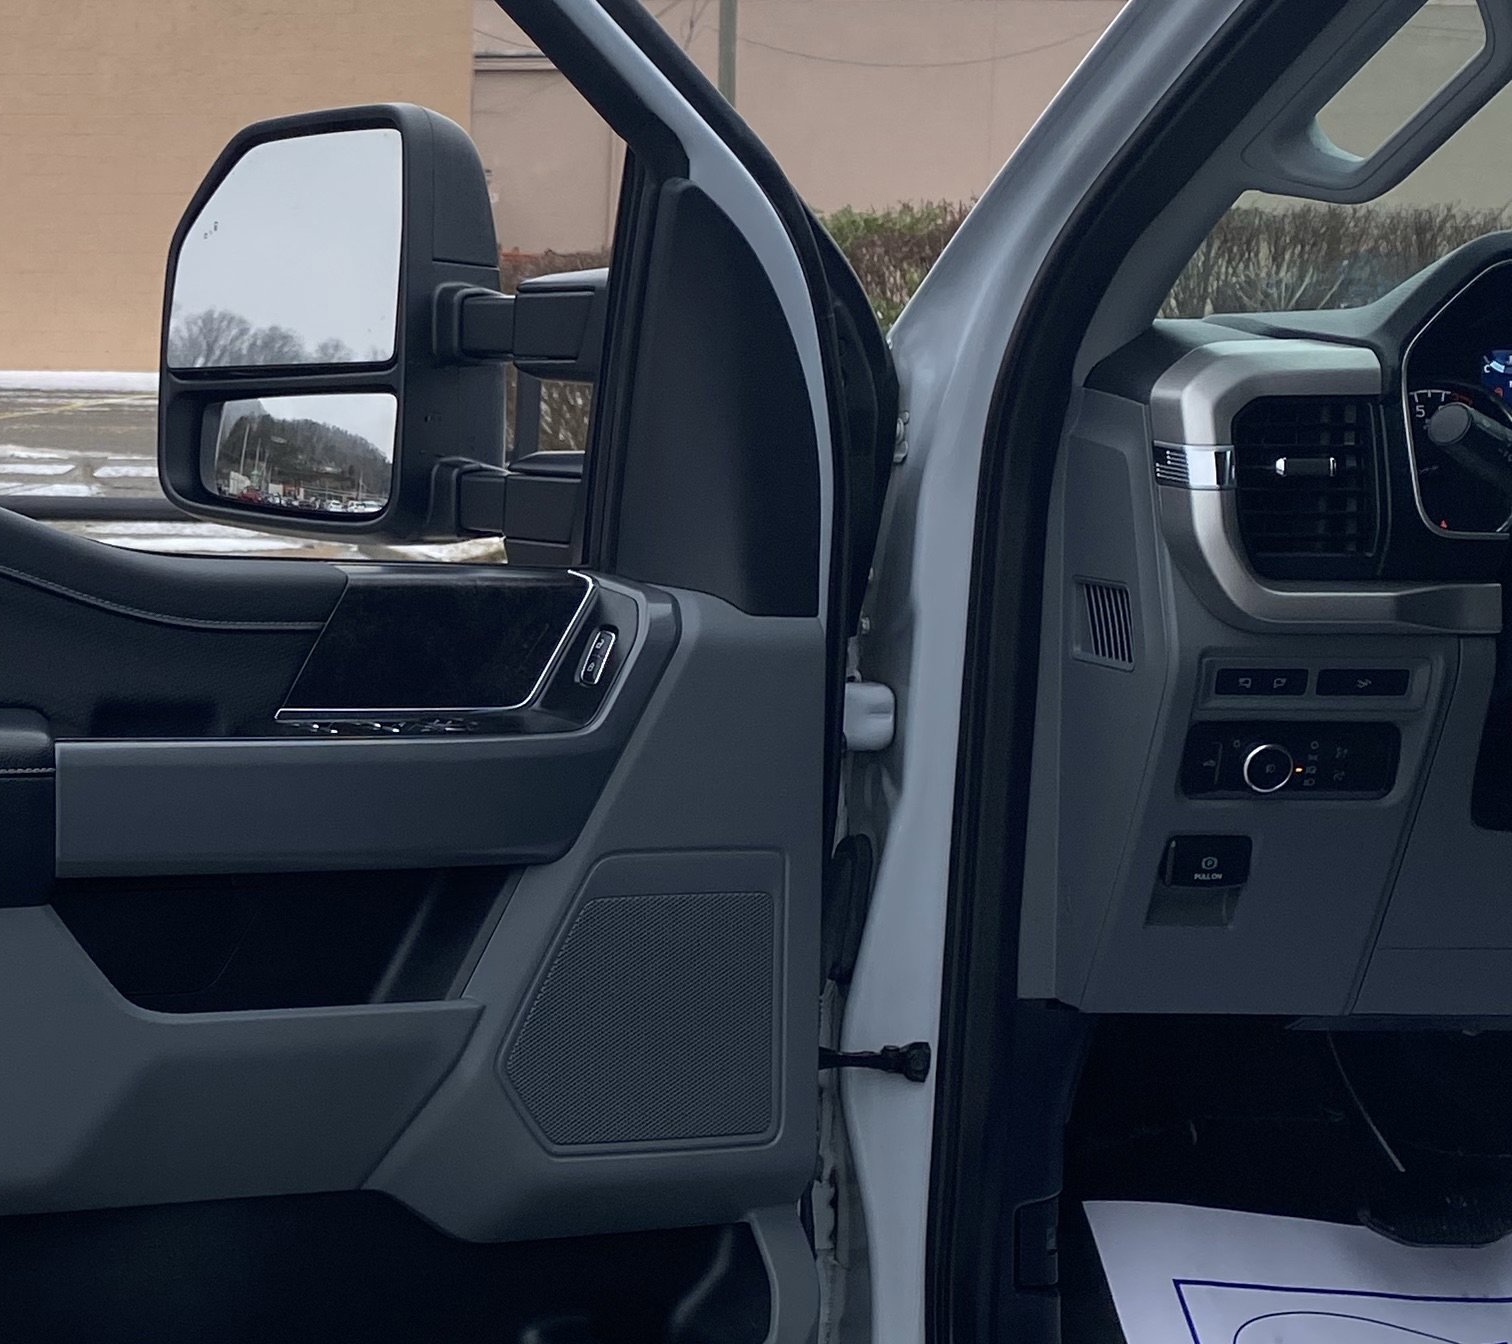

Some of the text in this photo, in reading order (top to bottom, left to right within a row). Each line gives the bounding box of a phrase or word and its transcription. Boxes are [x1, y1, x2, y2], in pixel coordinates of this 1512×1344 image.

[1415, 405, 1426, 418] 5
[1193, 872, 1223, 881] PULL ON
